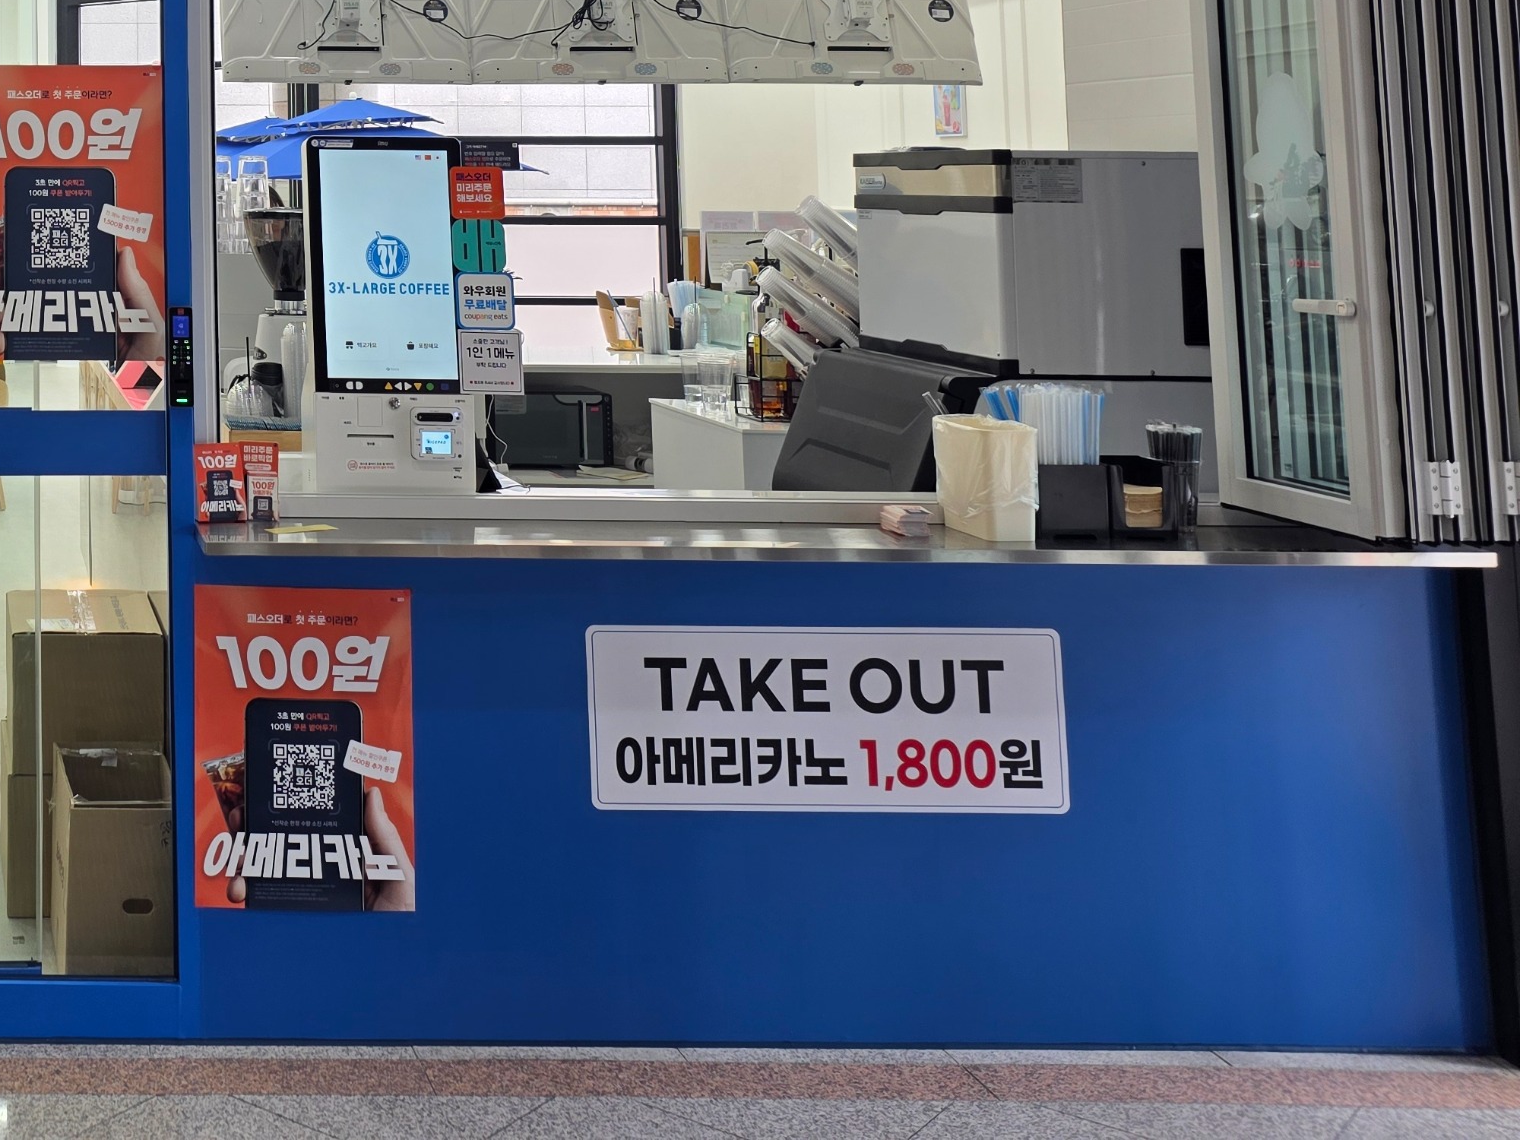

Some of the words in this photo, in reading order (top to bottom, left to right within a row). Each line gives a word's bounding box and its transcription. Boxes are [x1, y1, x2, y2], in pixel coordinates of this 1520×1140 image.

[456, 183, 492, 192] 미리주문
[457, 194, 493, 203] 해보세요
[328, 281, 396, 296] 3X-LARGE
[399, 282, 450, 296] COFFEE
[463, 285, 506, 297] 와우회원
[464, 299, 507, 310] 무료배달
[466, 346, 483, 359] 1인
[197, 454, 238, 469] 100원
[200, 499, 245, 512] 아메리카노
[216, 635, 391, 692] 100원
[643, 657, 831, 712] TAKE
[849, 657, 1005, 715] OUT
[270, 723, 292, 731] 100원
[615, 736, 849, 786] 아메리카노
[859, 738, 1044, 791] 1,800원
[202, 831, 406, 881] 아메리카노
